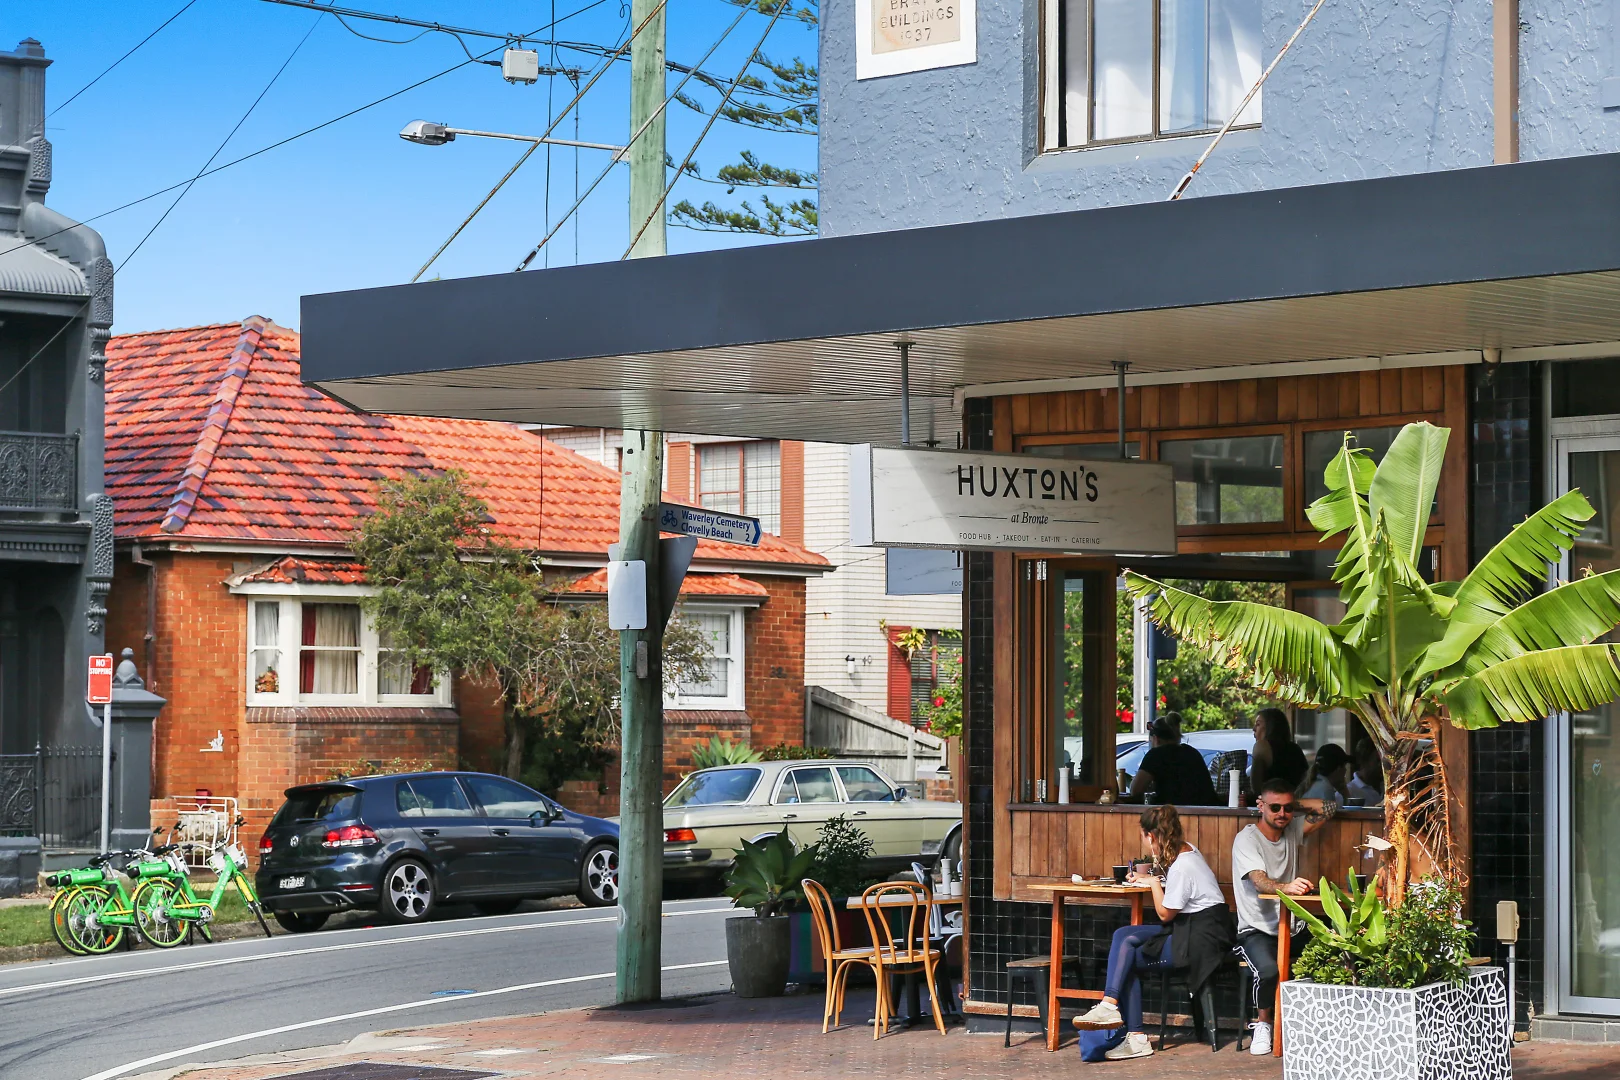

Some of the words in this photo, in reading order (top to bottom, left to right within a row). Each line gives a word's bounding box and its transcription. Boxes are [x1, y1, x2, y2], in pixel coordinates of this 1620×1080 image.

[880, 6, 954, 29] BUILDINGS
[900, 27, 931, 42] 1937
[957, 464, 1099, 502] HUXTON'S
[681, 509, 716, 526] Waverley
[716, 516, 751, 532] Cemetery
[1010, 513, 1019, 524] at
[1021, 511, 1049, 525] Bronte
[681, 522, 710, 537] Clovelly
[711, 527, 733, 539] Beach
[745, 533, 750, 542] 2
[959, 532, 977, 540] FOOD
[978, 533, 991, 541] HUB
[1003, 534, 1029, 542] TAKEOUT
[1041, 535, 1060, 543] EAT-IN
[1071, 536, 1100, 545] CATERING
[95, 659, 106, 667] NO
